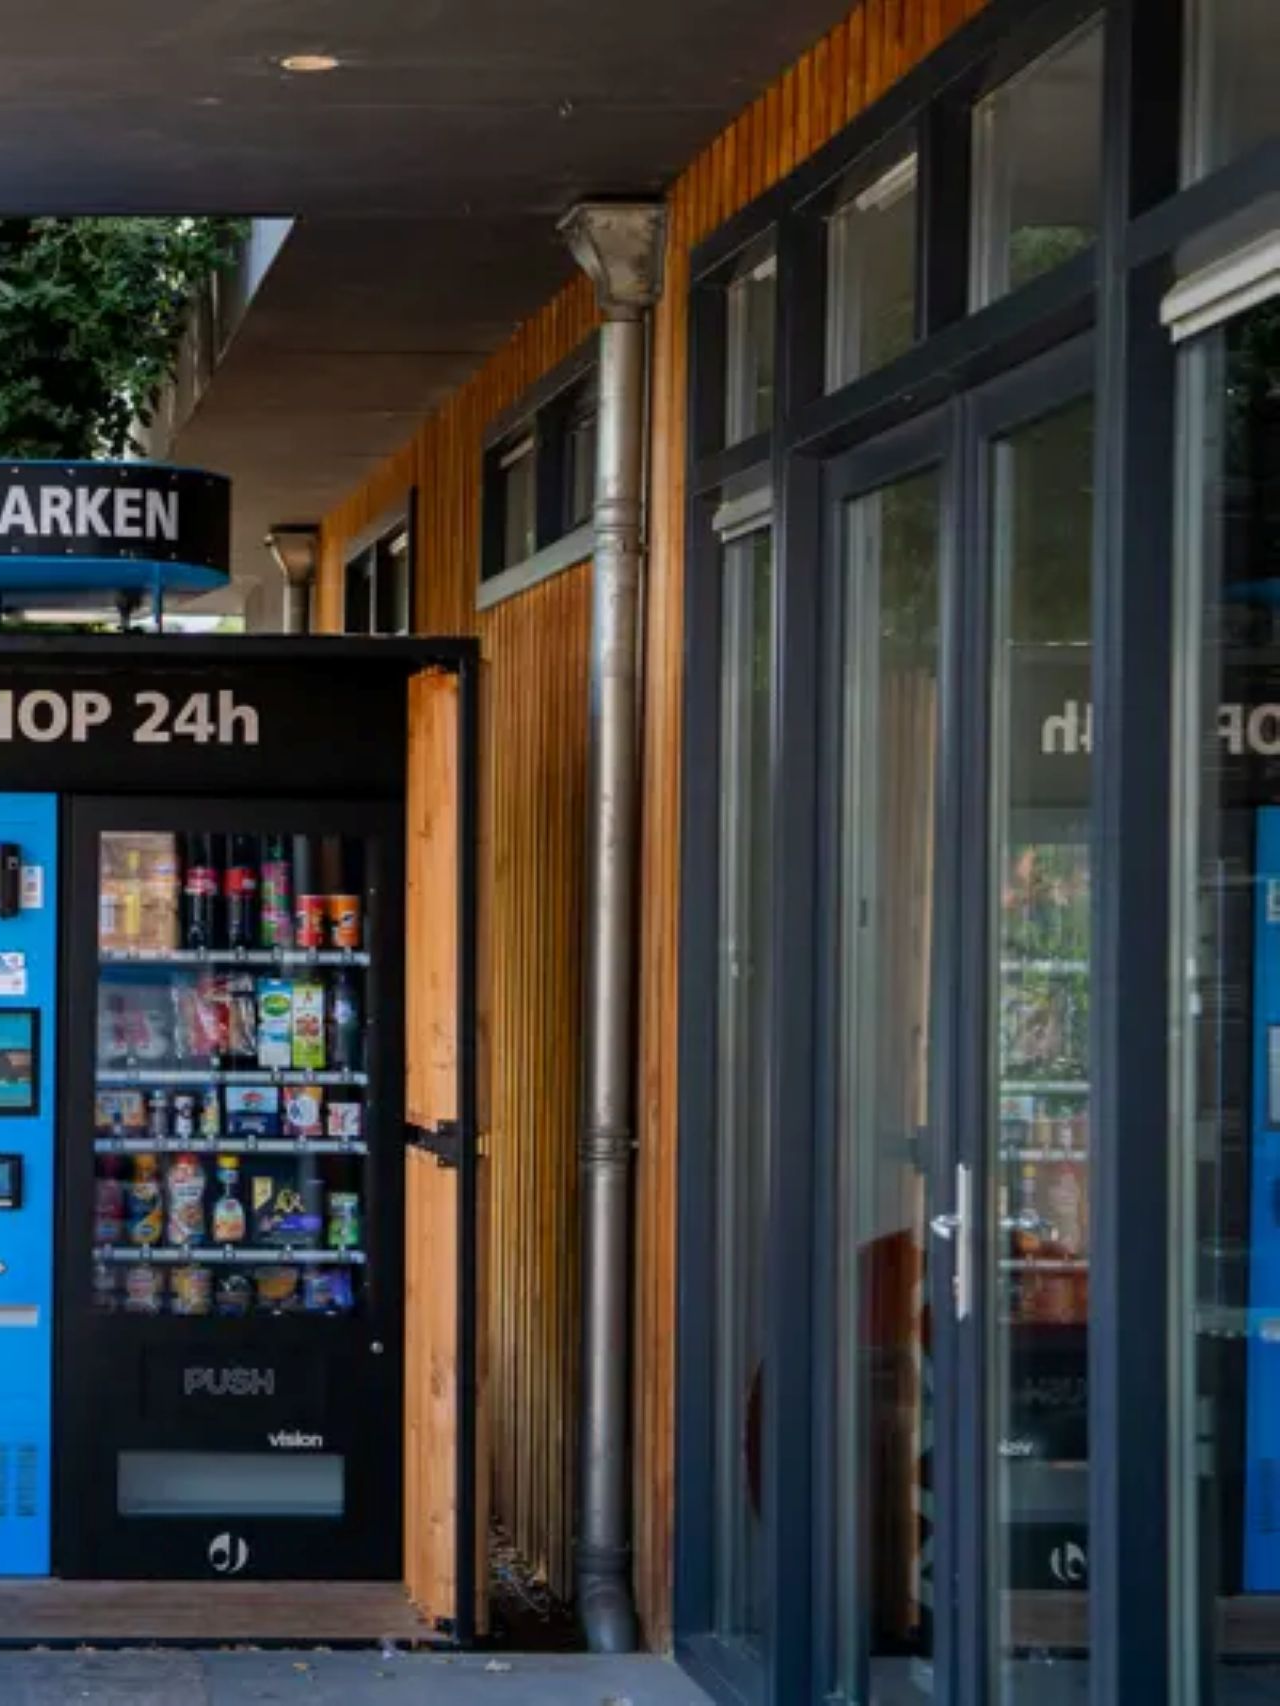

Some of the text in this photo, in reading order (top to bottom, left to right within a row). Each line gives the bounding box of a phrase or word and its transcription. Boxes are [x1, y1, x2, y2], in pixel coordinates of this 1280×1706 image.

[133, 689, 259, 744] 24h
[183, 1368, 275, 1395] PUSH
[268, 1430, 323, 1447] vision
